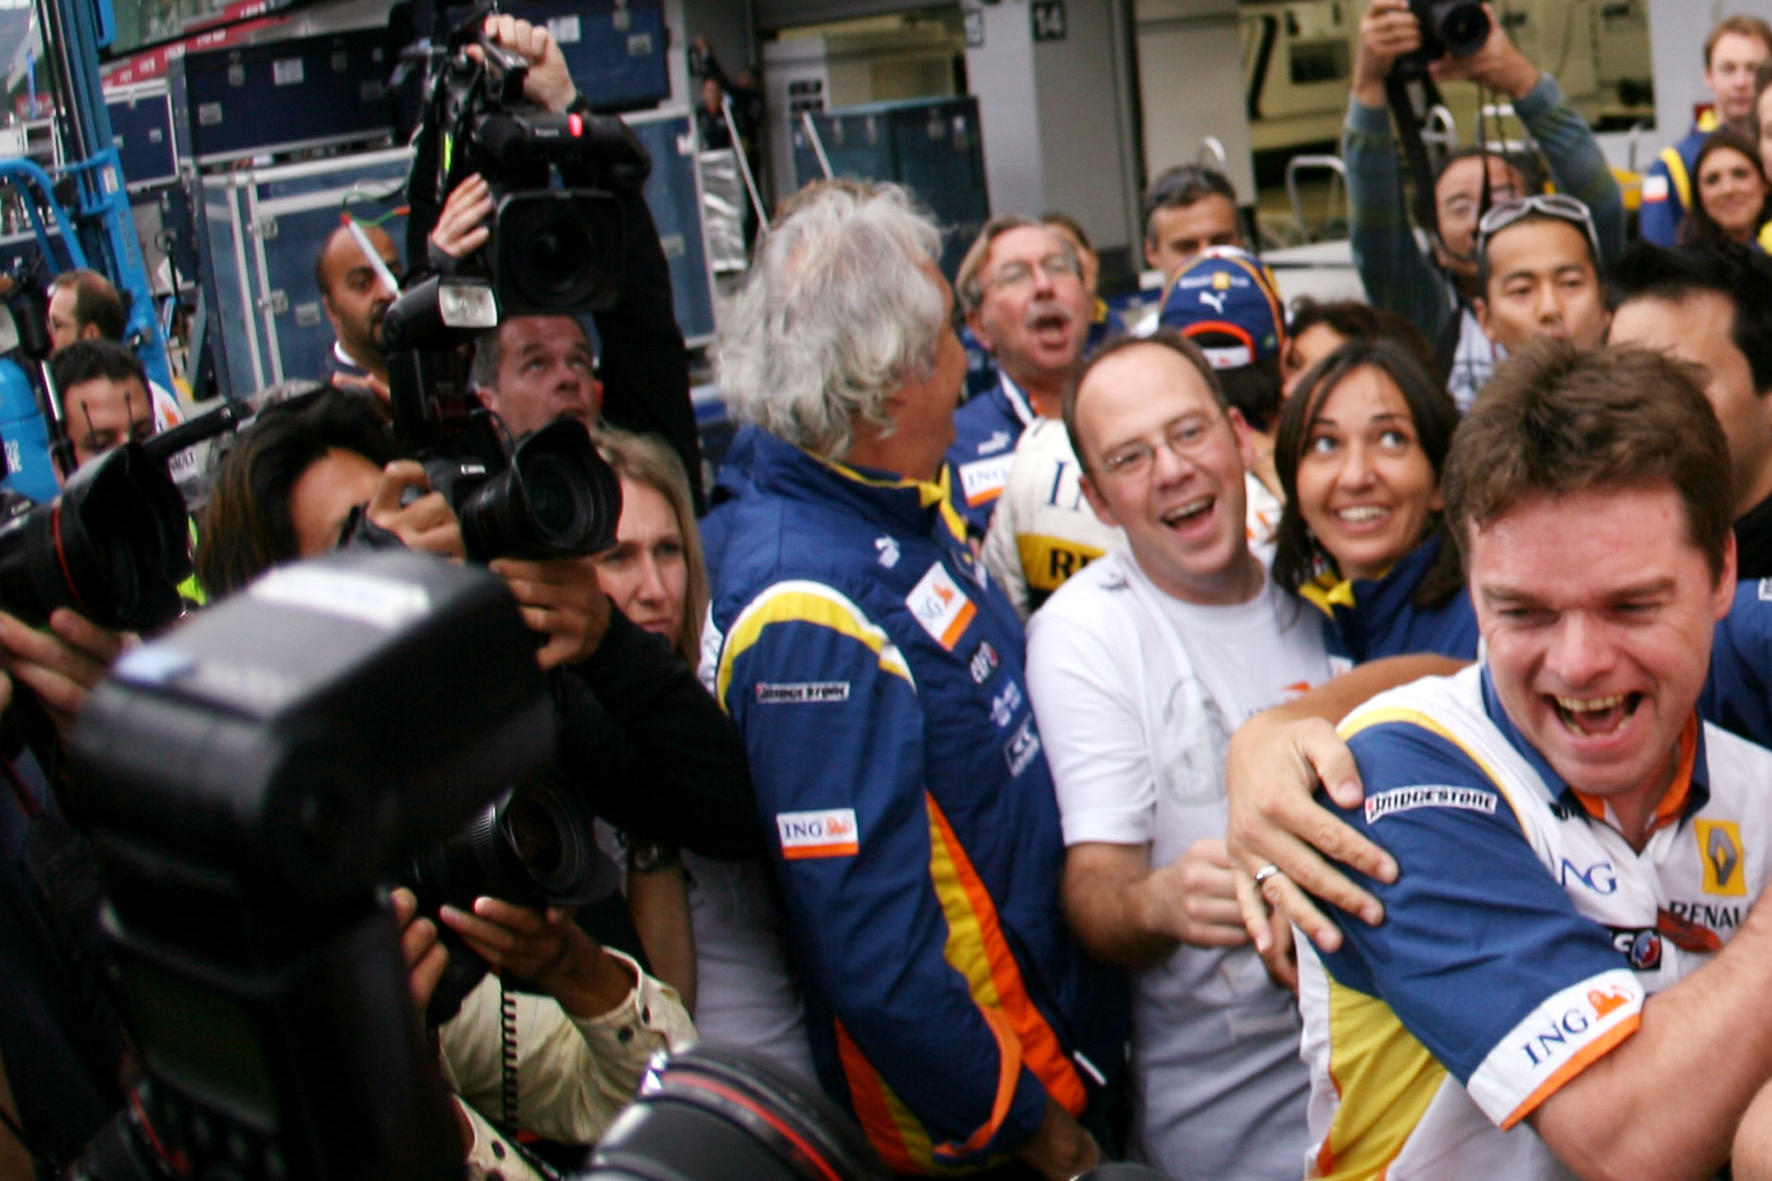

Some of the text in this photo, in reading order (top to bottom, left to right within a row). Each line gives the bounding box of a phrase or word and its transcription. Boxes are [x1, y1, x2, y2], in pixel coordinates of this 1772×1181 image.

[1034, 5, 1063, 36] 14
[1366, 788, 1493, 820] BRIDGESTONE
[784, 822, 823, 838] ING
[1521, 1008, 1589, 1068] ING
